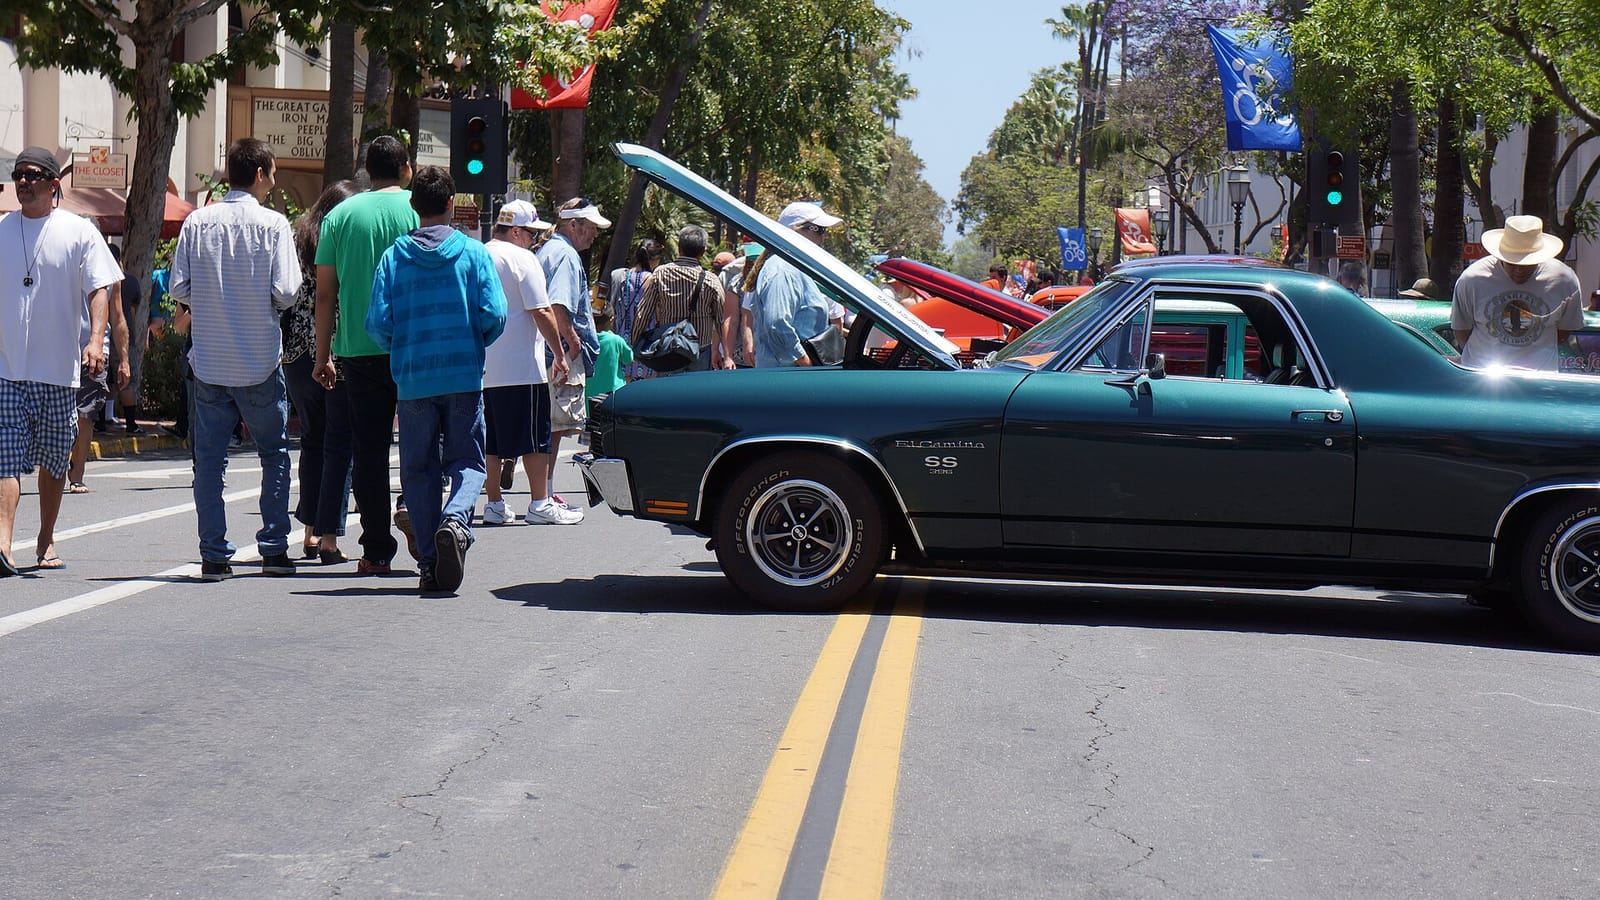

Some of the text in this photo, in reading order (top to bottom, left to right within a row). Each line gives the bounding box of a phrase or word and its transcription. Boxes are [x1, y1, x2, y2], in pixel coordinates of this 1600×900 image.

[256, 101, 274, 111] THE
[276, 102, 310, 112] GREAT
[312, 103, 330, 113] GA
[281, 112, 308, 122] IRON
[267, 135, 286, 145] THE
[297, 136, 314, 146] BIG
[75, 166, 124, 177] THE CLOSET
[924, 456, 959, 468] SS
[735, 469, 790, 554] BFGoodrich
[844, 518, 864, 574] Radial
[1540, 507, 1598, 591] BFGoodrich
